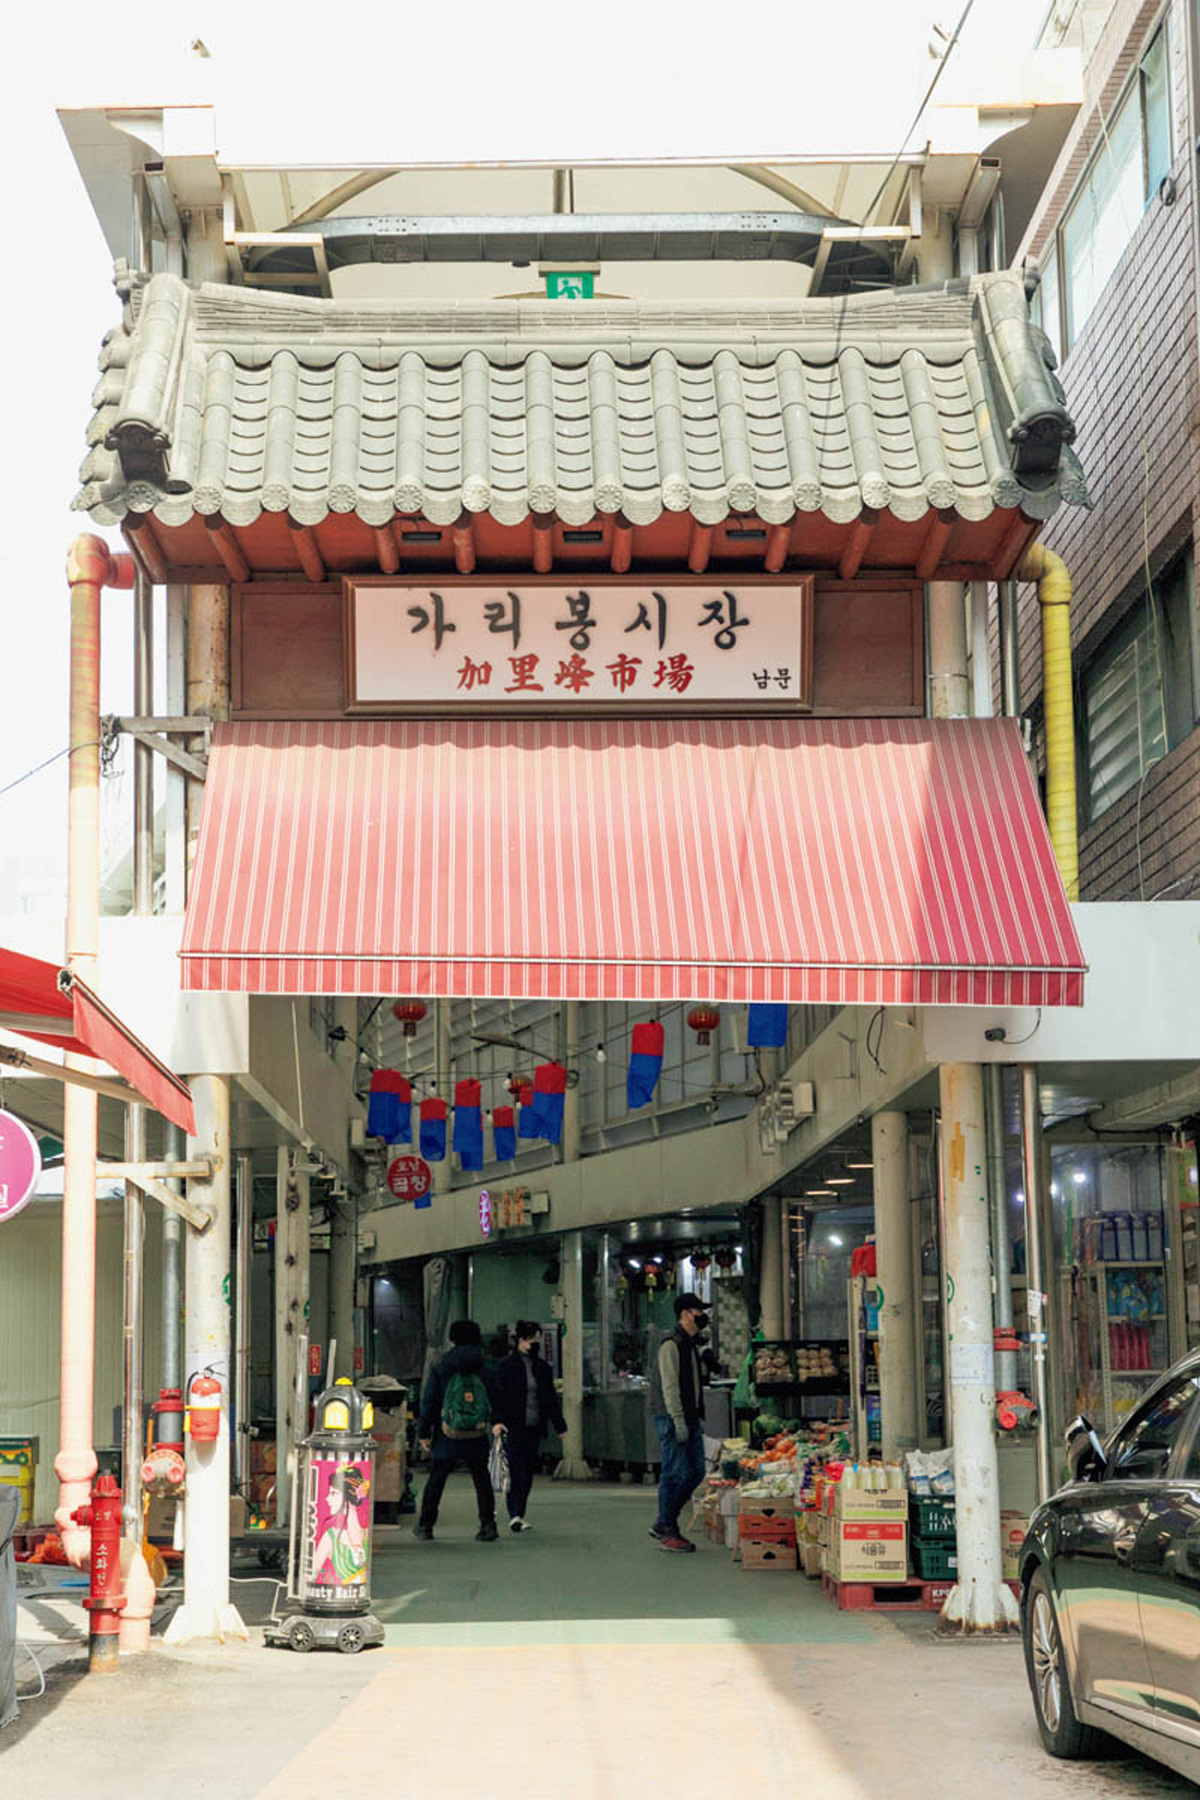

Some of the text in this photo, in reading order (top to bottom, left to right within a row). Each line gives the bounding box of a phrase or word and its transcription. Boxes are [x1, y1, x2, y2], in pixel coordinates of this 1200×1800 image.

[407, 591, 750, 650] 가리봉시장
[457, 653, 695, 693] 加里峰市場
[752, 668, 791, 690] 남문
